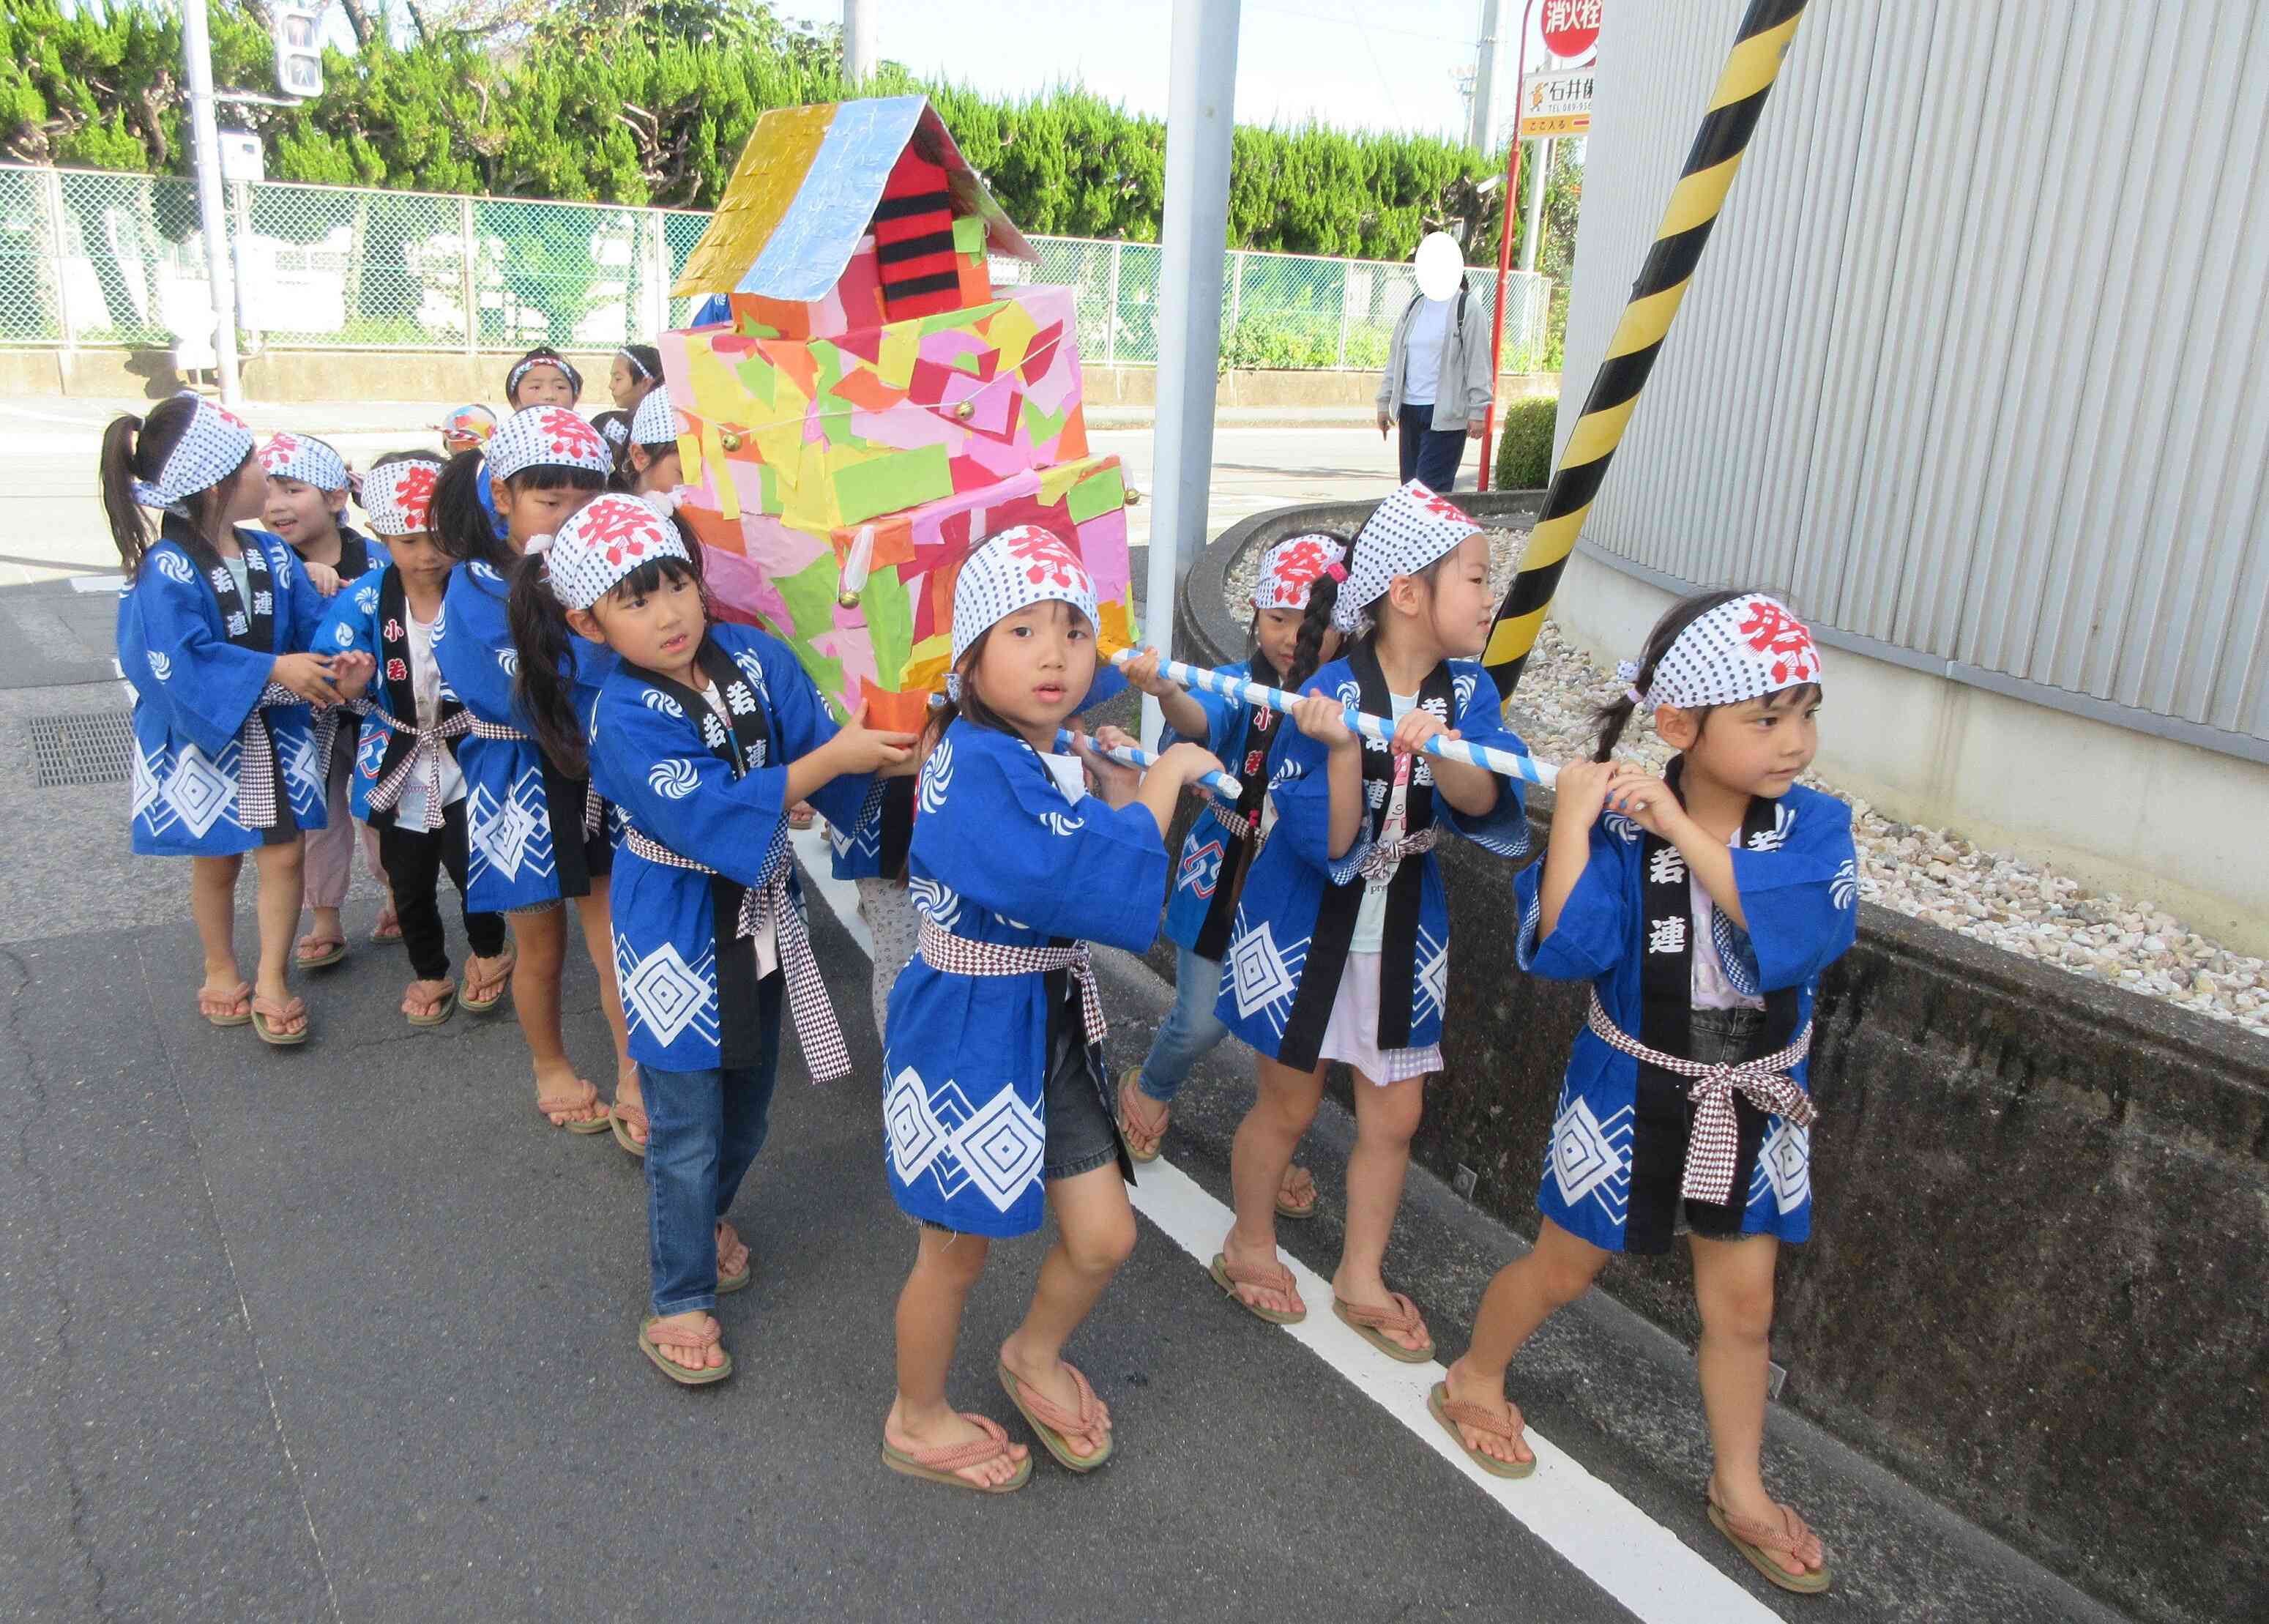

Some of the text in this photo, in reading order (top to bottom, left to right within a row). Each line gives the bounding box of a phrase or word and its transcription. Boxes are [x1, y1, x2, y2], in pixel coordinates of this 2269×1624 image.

[1546, 0, 1601, 34] 消火栓
[1530, 119, 1565, 130] ここ入る
[578, 499, 663, 566] 祭
[1007, 526, 1089, 593] 祭
[211, 567, 250, 638] 若連
[245, 548, 273, 615] 若連
[384, 618, 408, 681] 小若
[1740, 602, 1820, 684] 祭
[1649, 846, 1685, 954] 若連
